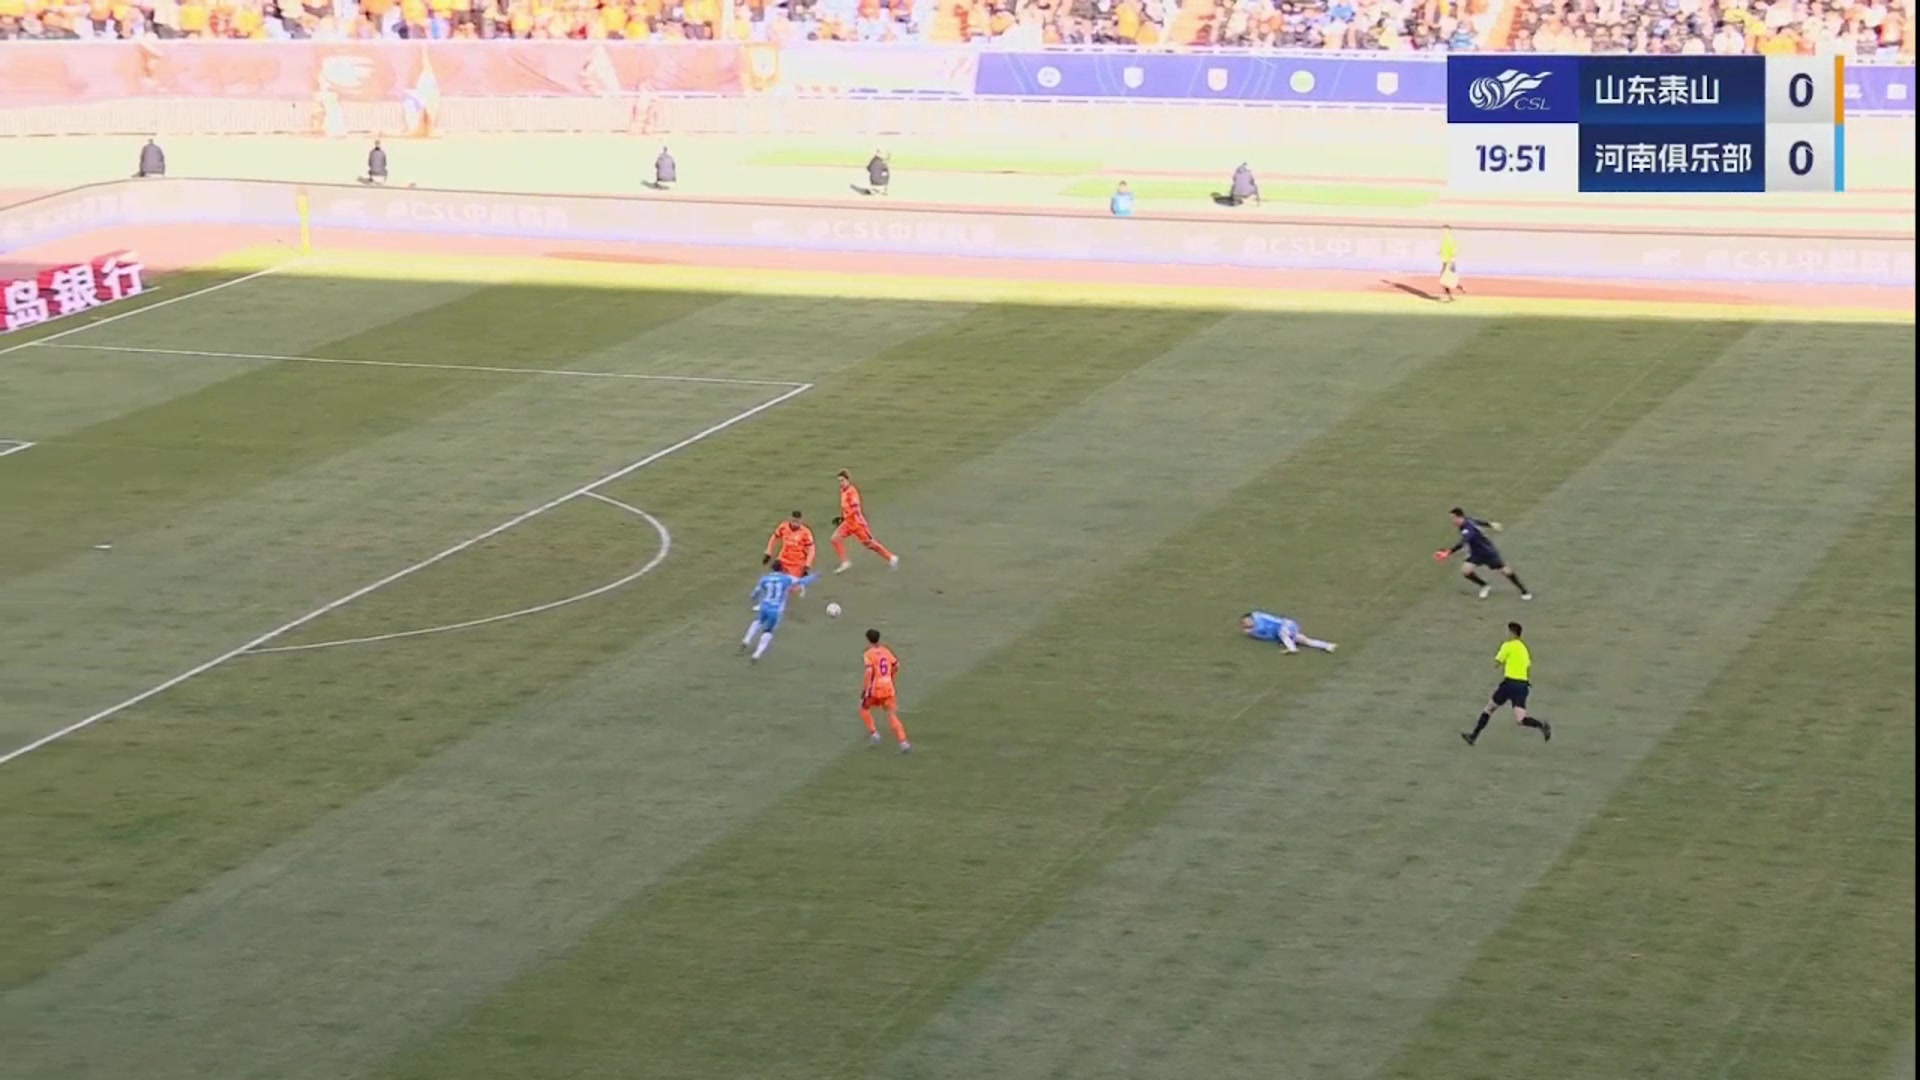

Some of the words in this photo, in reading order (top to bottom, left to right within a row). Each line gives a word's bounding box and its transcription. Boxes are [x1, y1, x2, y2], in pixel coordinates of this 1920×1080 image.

[4, 251, 145, 330] 岛银行
[764, 582, 783, 601] 11
